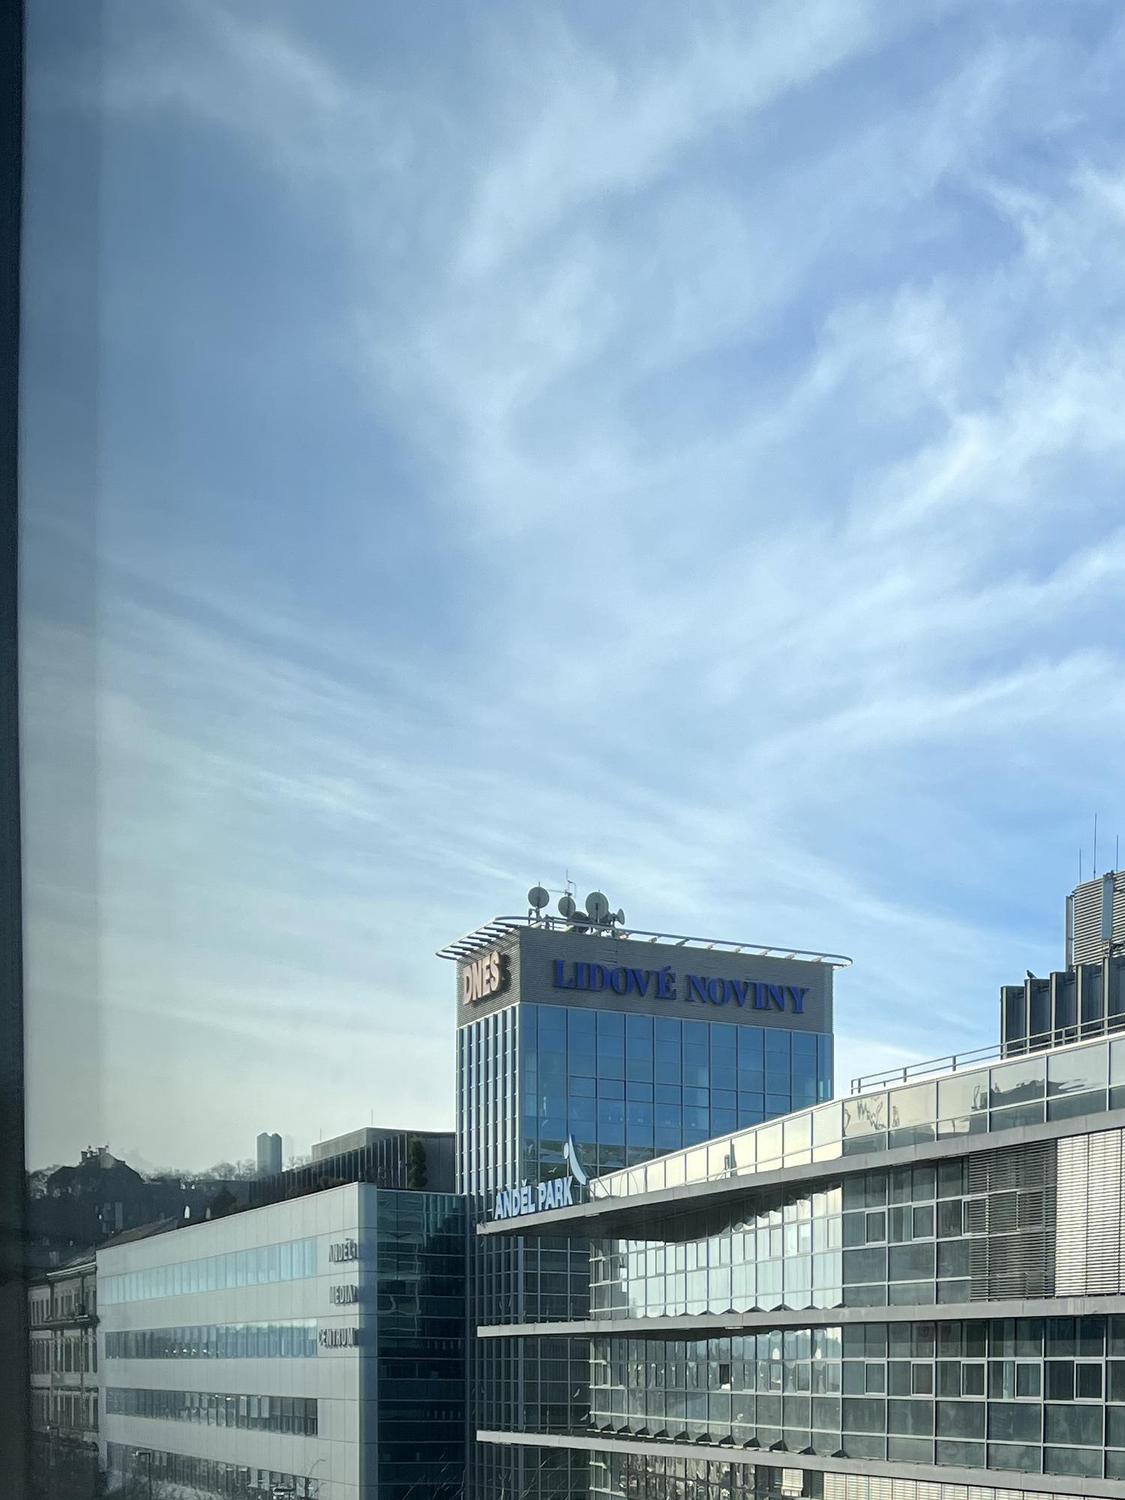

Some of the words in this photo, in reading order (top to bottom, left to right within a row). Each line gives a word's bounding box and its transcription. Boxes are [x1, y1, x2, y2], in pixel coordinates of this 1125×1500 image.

[463, 950, 500, 1005] DNES
[553, 959, 677, 1000] LIDOVÉ
[684, 973, 809, 1014] NOVINY
[494, 1178, 536, 1220] ANDĚL
[537, 1175, 573, 1211] PARK
